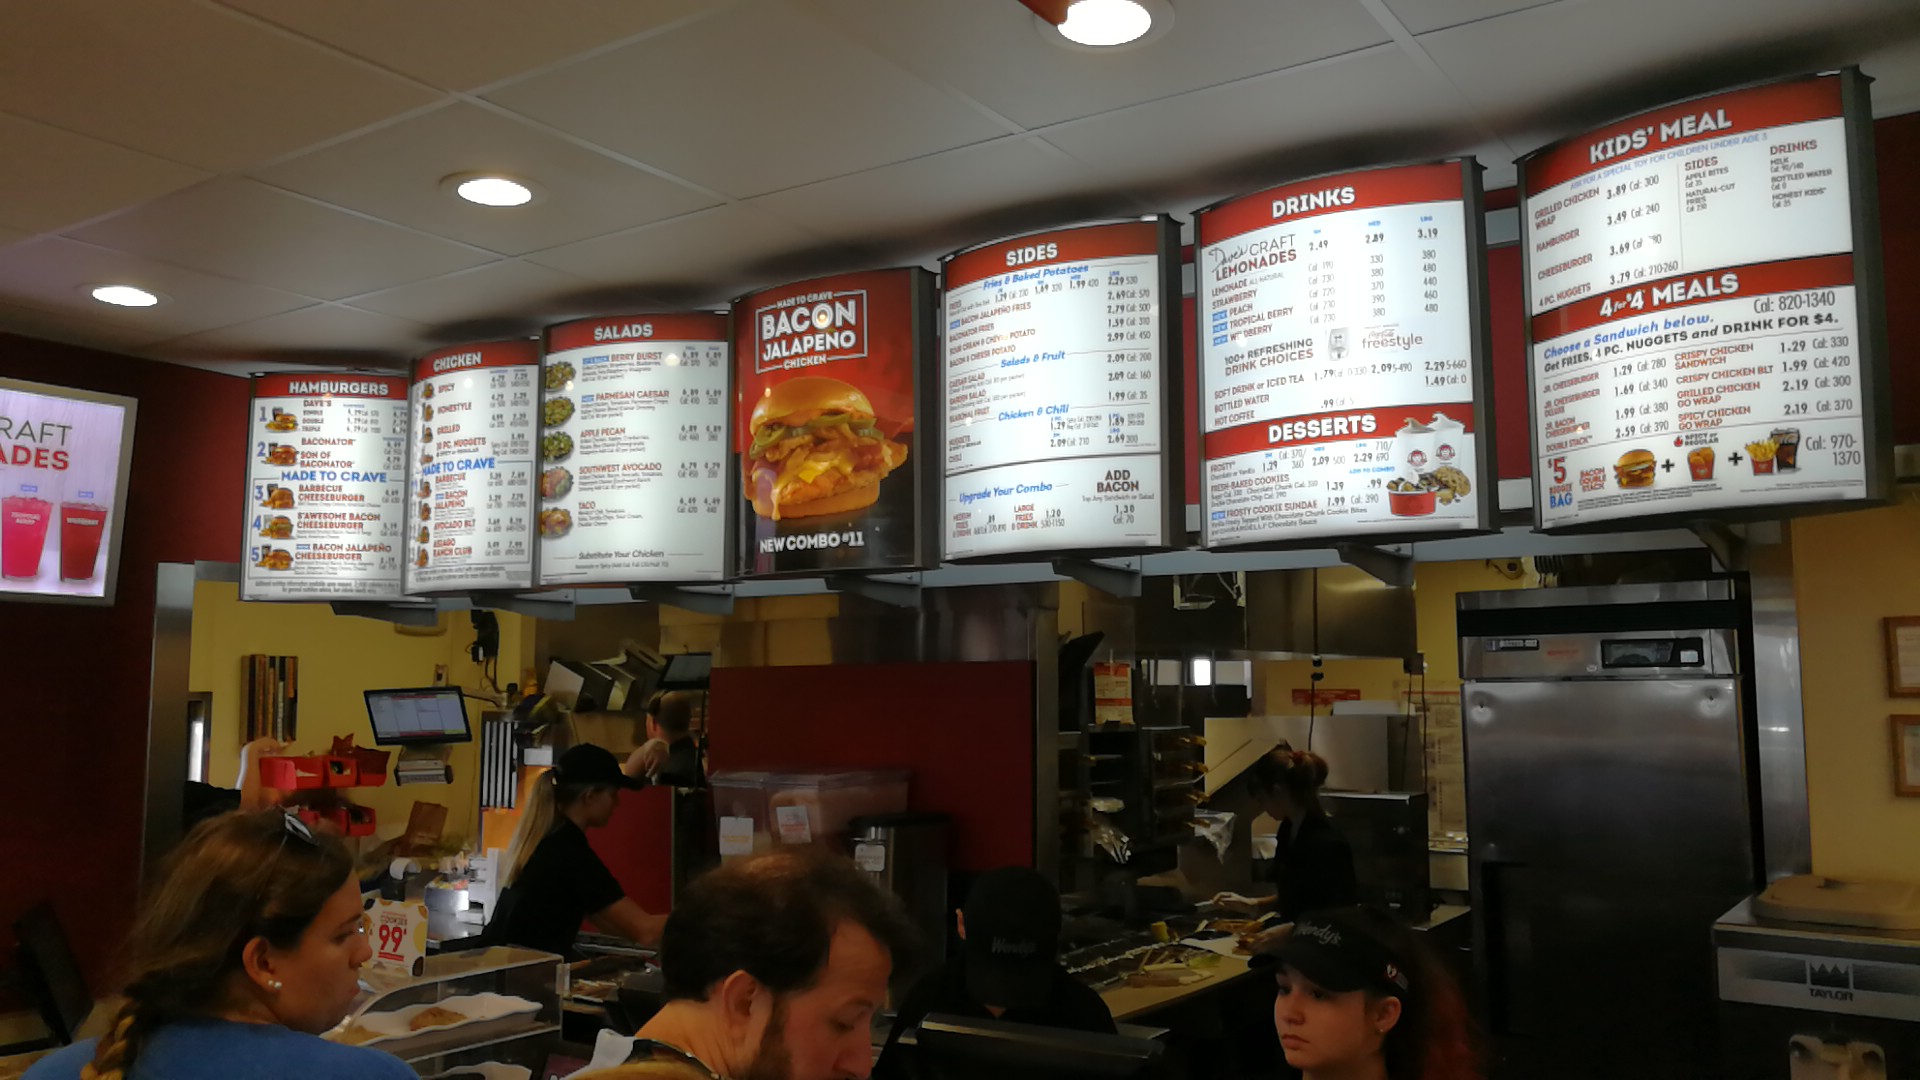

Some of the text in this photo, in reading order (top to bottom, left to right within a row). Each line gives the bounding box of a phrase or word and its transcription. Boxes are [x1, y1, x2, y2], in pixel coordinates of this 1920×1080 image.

[1588, 108, 1733, 165] KIDS' MEAL
[1770, 139, 1818, 155] DRINKS
[1684, 156, 1719, 171] SIDES
[1606, 183, 1627, 200] 3.89
[1272, 185, 1355, 219] DRINKS
[1607, 210, 1627, 226] 3.49
[1417, 228, 1438, 239] 3.19
[1535, 228, 1581, 252] HAMBURGER
[1249, 234, 1296, 256] CRAFT
[1609, 242, 1630, 257] 3.69
[1005, 242, 1058, 267] SIDES
[1215, 249, 1297, 282] LEMONADES
[1537, 254, 1593, 281] CHEESEBURGER
[983, 264, 1089, 290] Fries Baked Potatoes
[1609, 270, 1631, 285] 3.79
[1211, 278, 1248, 296] LEMONADE
[1556, 283, 1592, 304] NUGGETS
[1651, 272, 1739, 307] MEALS
[796, 295, 806, 304] TO
[807, 292, 833, 302] CRAVE
[1753, 290, 1835, 314] Cal: 820-1340
[762, 299, 856, 341] BACON
[1229, 307, 1294, 329] TROPICAL BERRY
[594, 324, 653, 340] SALADS
[1544, 313, 1715, 360] Choose a Sandwich below.
[1247, 337, 1314, 359] REFRESHING
[1362, 333, 1423, 350] freestyle
[1544, 359, 1561, 374] Get
[1604, 343, 1623, 357] PC.
[1626, 331, 1688, 351] NUGGETS
[1691, 325, 1719, 339] and
[1722, 317, 1773, 335] DRINK
[1777, 314, 1809, 328] FOR
[1813, 312, 1839, 326] $4.
[1780, 340, 1806, 354] 1.29
[611, 352, 662, 362] BERRY BURST
[1041, 351, 1066, 361] Fruit
[1674, 343, 1754, 361] CRISPY CHICKEN
[433, 352, 482, 372] CHICKEN
[783, 354, 827, 370] CHICKEN
[1225, 349, 1314, 376] DRINK CHOICES
[1425, 361, 1445, 372] 2.29
[1674, 355, 1727, 371] SANDWICH
[1782, 359, 1808, 373] 1.99
[1613, 364, 1633, 377] 1.29
[1676, 364, 1774, 385] CRISPY CHICKEN BLT
[288, 381, 388, 395] HAMBURGERS
[596, 390, 669, 401] PARMESAN CAESAR
[1676, 382, 1761, 400] GRILLED CHICKEN
[1244, 394, 1270, 407] WATER
[1677, 394, 1722, 408] GO WRAP
[999, 404, 1069, 421] Chicken Chili
[1678, 405, 1751, 422] SPICY CHICKEN
[1784, 403, 1808, 416] 2.19
[1268, 414, 1377, 445] DESSERTS
[1678, 417, 1723, 431] GO WRAP
[580, 428, 625, 438] APPLE PECAN
[257, 442, 266, 457] 2
[1805, 437, 1827, 452] Cal:
[422, 458, 494, 476] MADE TO CRAVE
[1831, 451, 1861, 467] 1370
[579, 462, 661, 474] SOUTHWEST AVOCADO
[1105, 470, 1131, 481] ADD
[281, 472, 387, 482] MADE TO CRAVE
[1254, 474, 1290, 485] COOKIES
[255, 485, 263, 500] 3
[960, 482, 1053, 504] Upgrade Your Combo
[1097, 481, 1139, 493] BACON
[298, 494, 364, 502] CHEESEBURGER
[1549, 494, 1573, 509] BAG
[1253, 502, 1283, 514] COOKIE
[253, 515, 261, 530] 4
[297, 521, 364, 529] CHEESEBURGER
[349, 513, 380, 521] BACON
[760, 531, 864, 554] NEW COMBO #11
[251, 547, 259, 561] 5
[632, 550, 664, 558] Chicken
[1809, 988, 1854, 1002] TAYLOR
